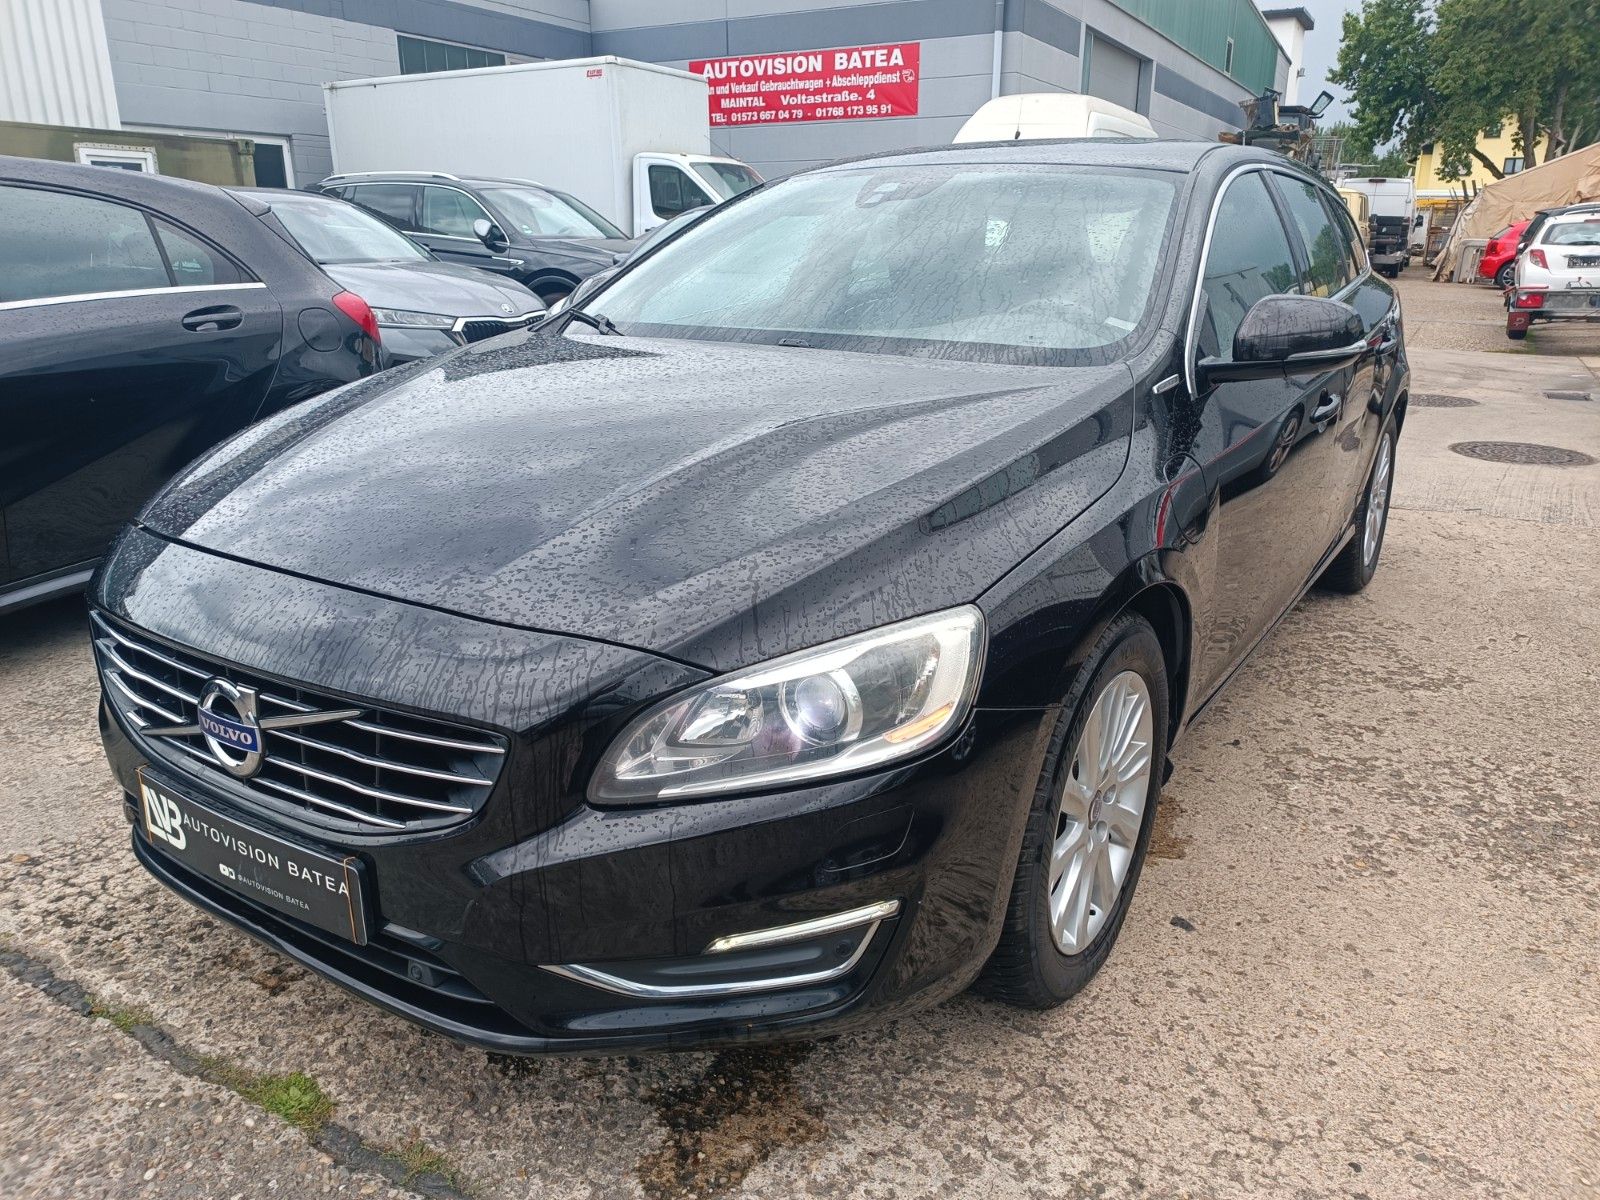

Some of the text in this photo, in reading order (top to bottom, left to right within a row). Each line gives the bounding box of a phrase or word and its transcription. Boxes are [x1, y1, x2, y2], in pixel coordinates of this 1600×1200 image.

[703, 48, 904, 80] AUTOVISION BATEA
[716, 84, 729, 94] und
[731, 81, 758, 94] Verkauf
[760, 78, 824, 92] Gebrauchtwagen
[826, 78, 831, 87] +
[832, 70, 900, 88] Abschleppdienst
[721, 89, 875, 108] MAINTAL Voltastraße. 4
[711, 113, 727, 122] TEL:
[731, 112, 757, 121] 01573
[760, 111, 775, 120] 667
[778, 110, 789, 119] 04
[792, 109, 802, 118] 79
[816, 106, 844, 117] 01768
[847, 106, 863, 115] 173
[866, 105, 878, 114] 95
[880, 104, 892, 113] 91
[200, 716, 252, 744] VOLVO
[183, 813, 350, 897] AUTOVISION BATEA
[237, 874, 310, 910] @AUTOVISION BATEA
